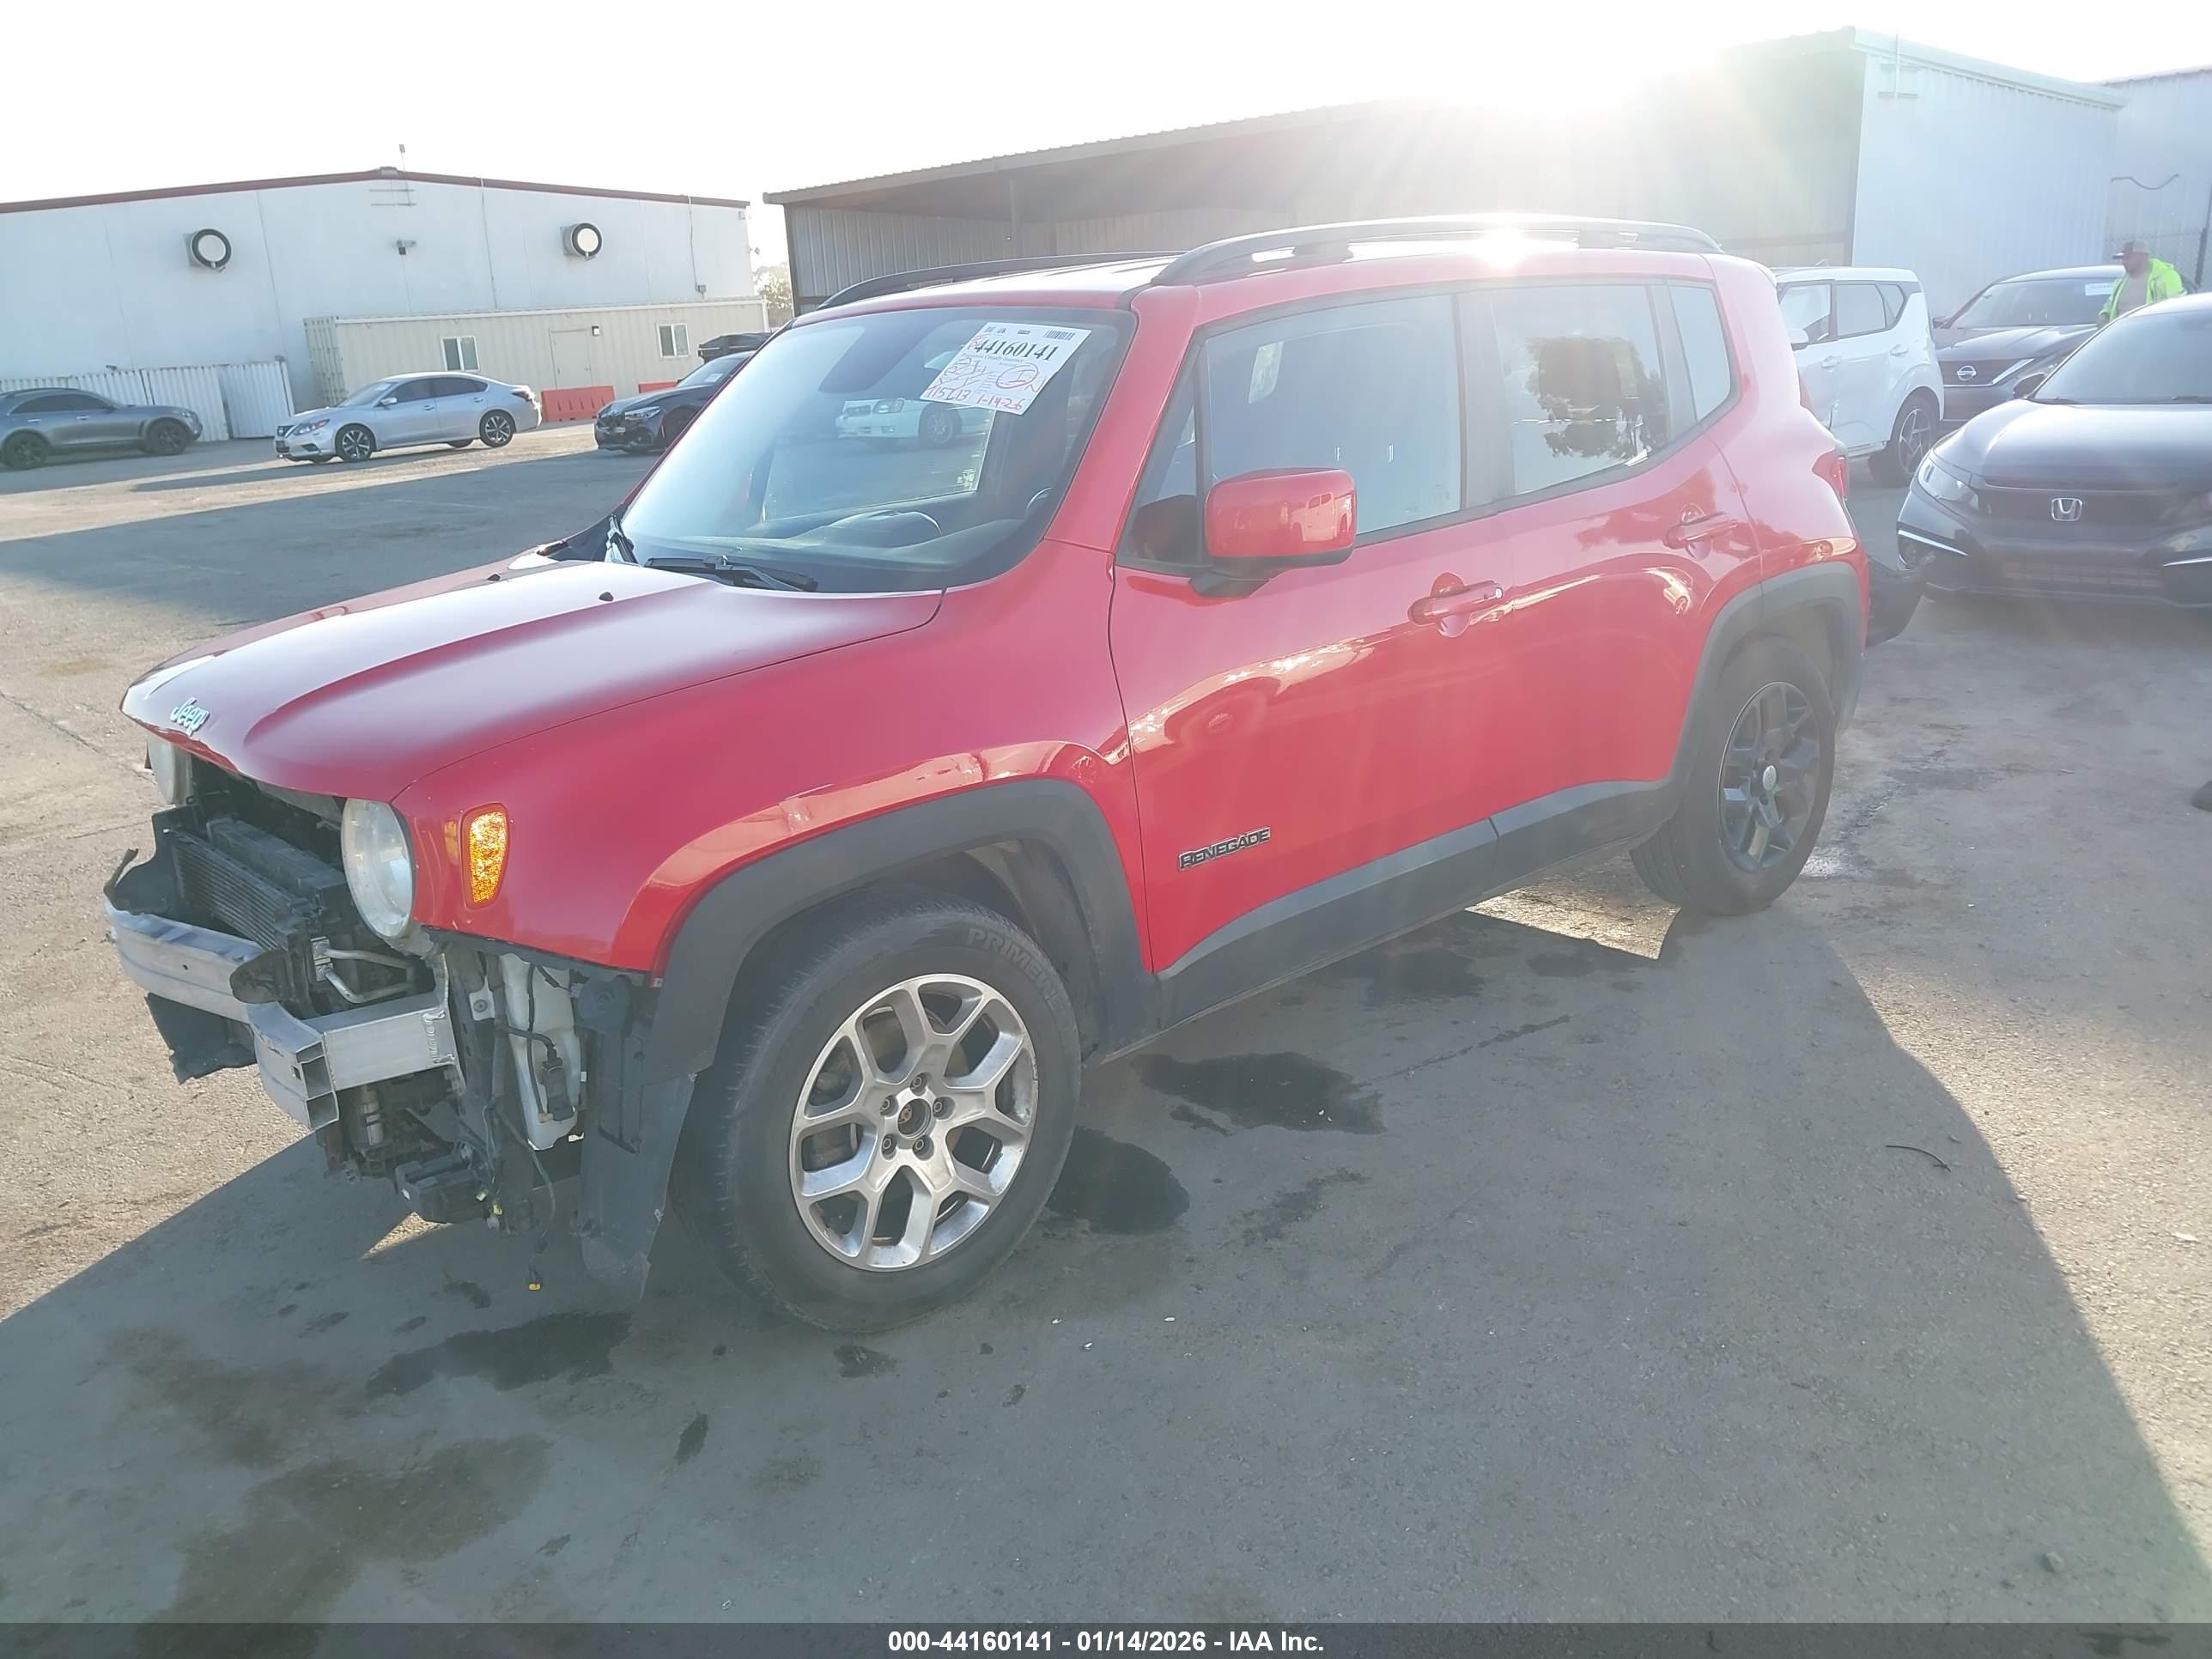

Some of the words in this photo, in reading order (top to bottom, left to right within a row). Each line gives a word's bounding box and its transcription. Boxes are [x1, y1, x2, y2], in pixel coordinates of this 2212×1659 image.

[974, 339, 1059, 361] 44160141
[170, 696, 210, 737] Jeep
[1178, 825, 1271, 872] RENEGADE
